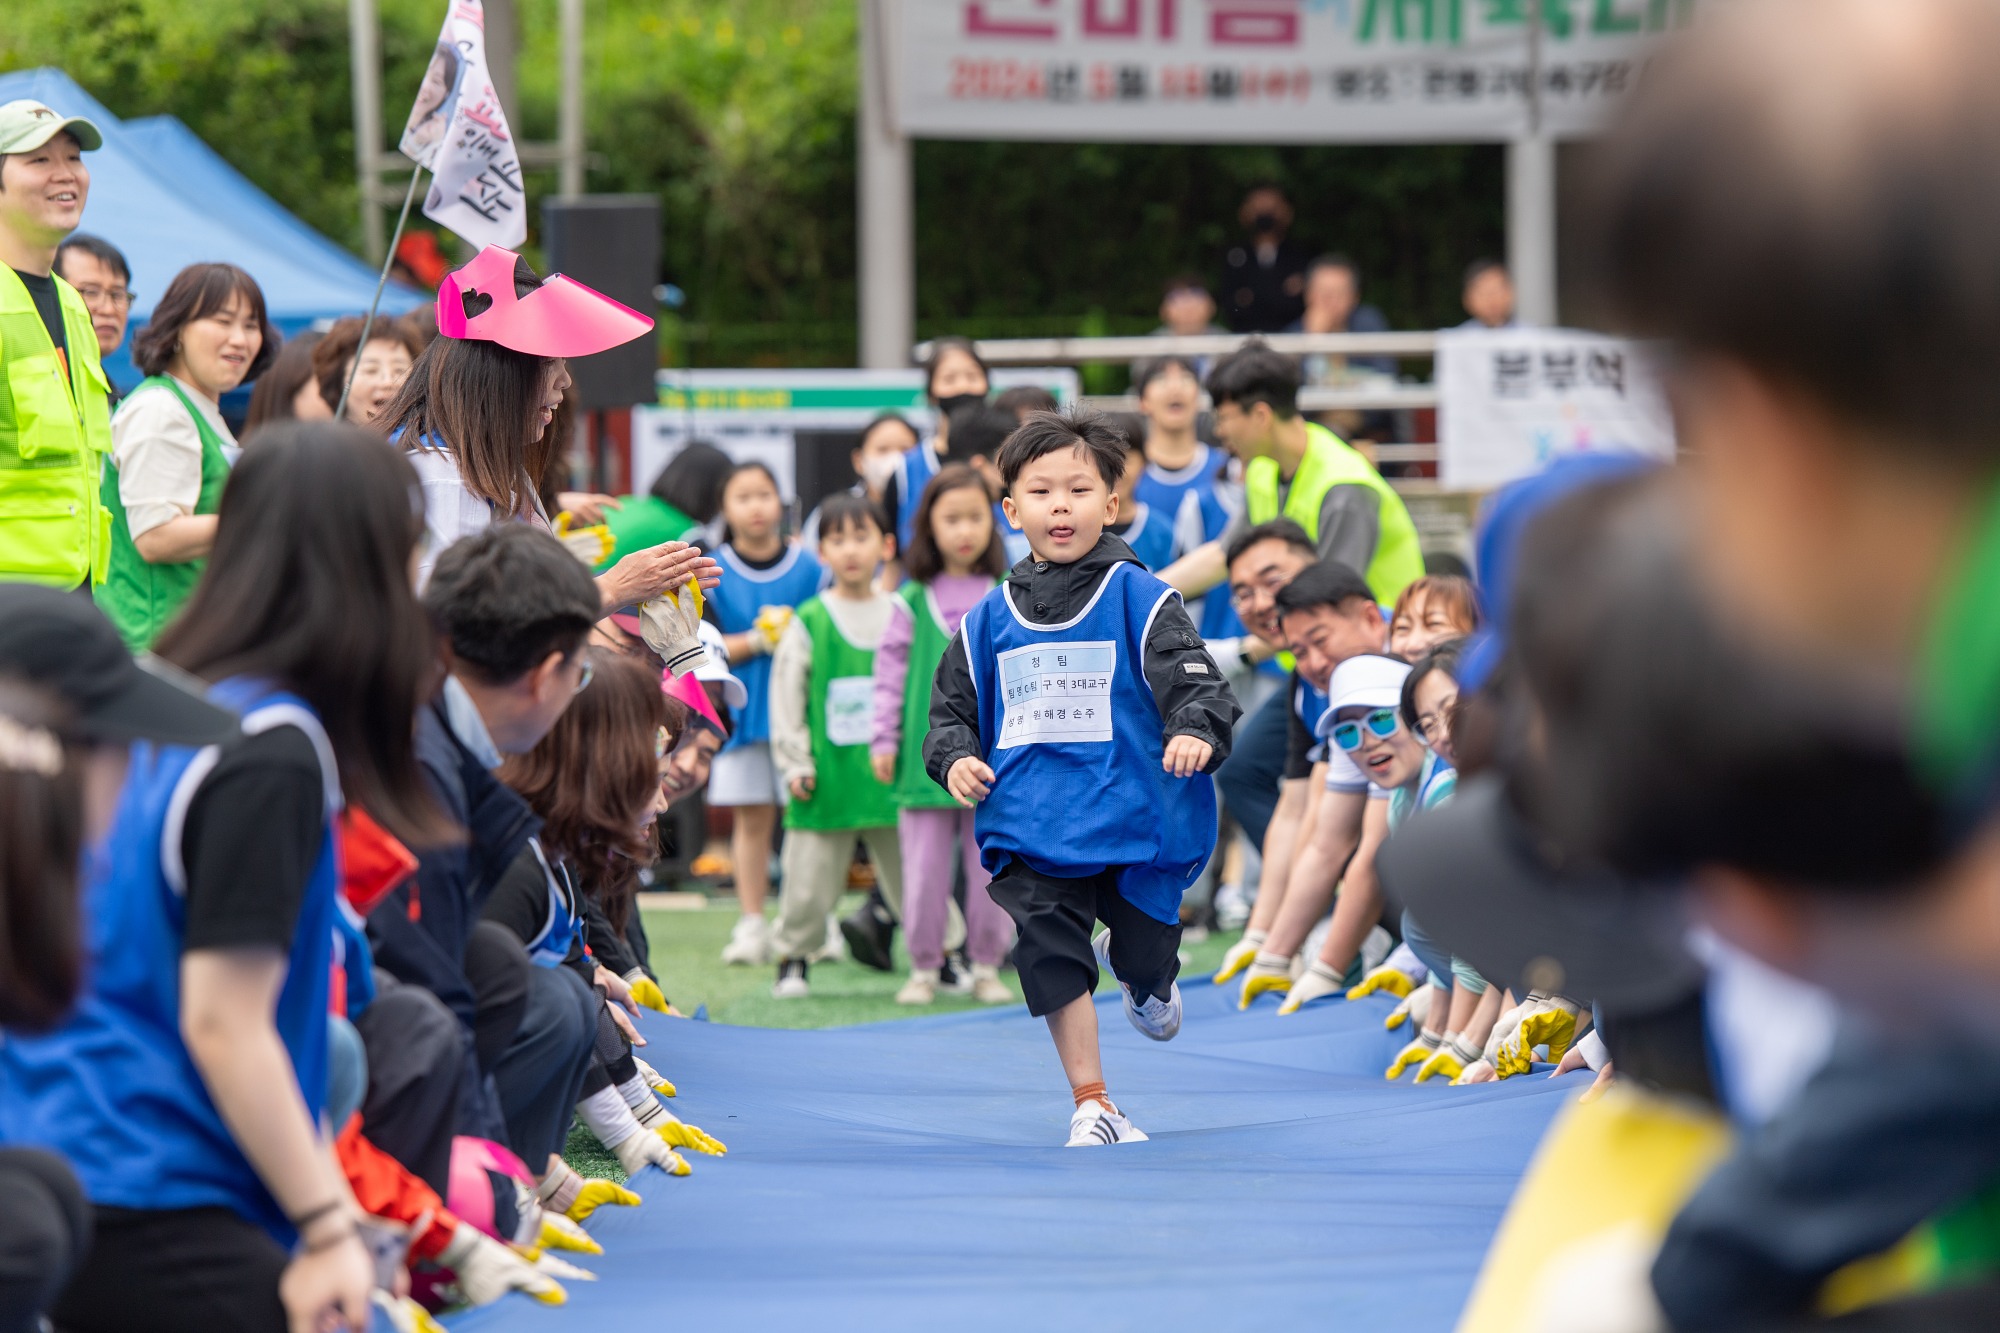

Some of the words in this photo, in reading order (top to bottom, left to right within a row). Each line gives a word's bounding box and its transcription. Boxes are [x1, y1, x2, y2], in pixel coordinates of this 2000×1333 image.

[1494, 350, 1626, 399] 본부석
[1031, 656, 1041, 668] 청
[1057, 655, 1067, 667] 팀
[1071, 678, 1108, 690] 3대교구
